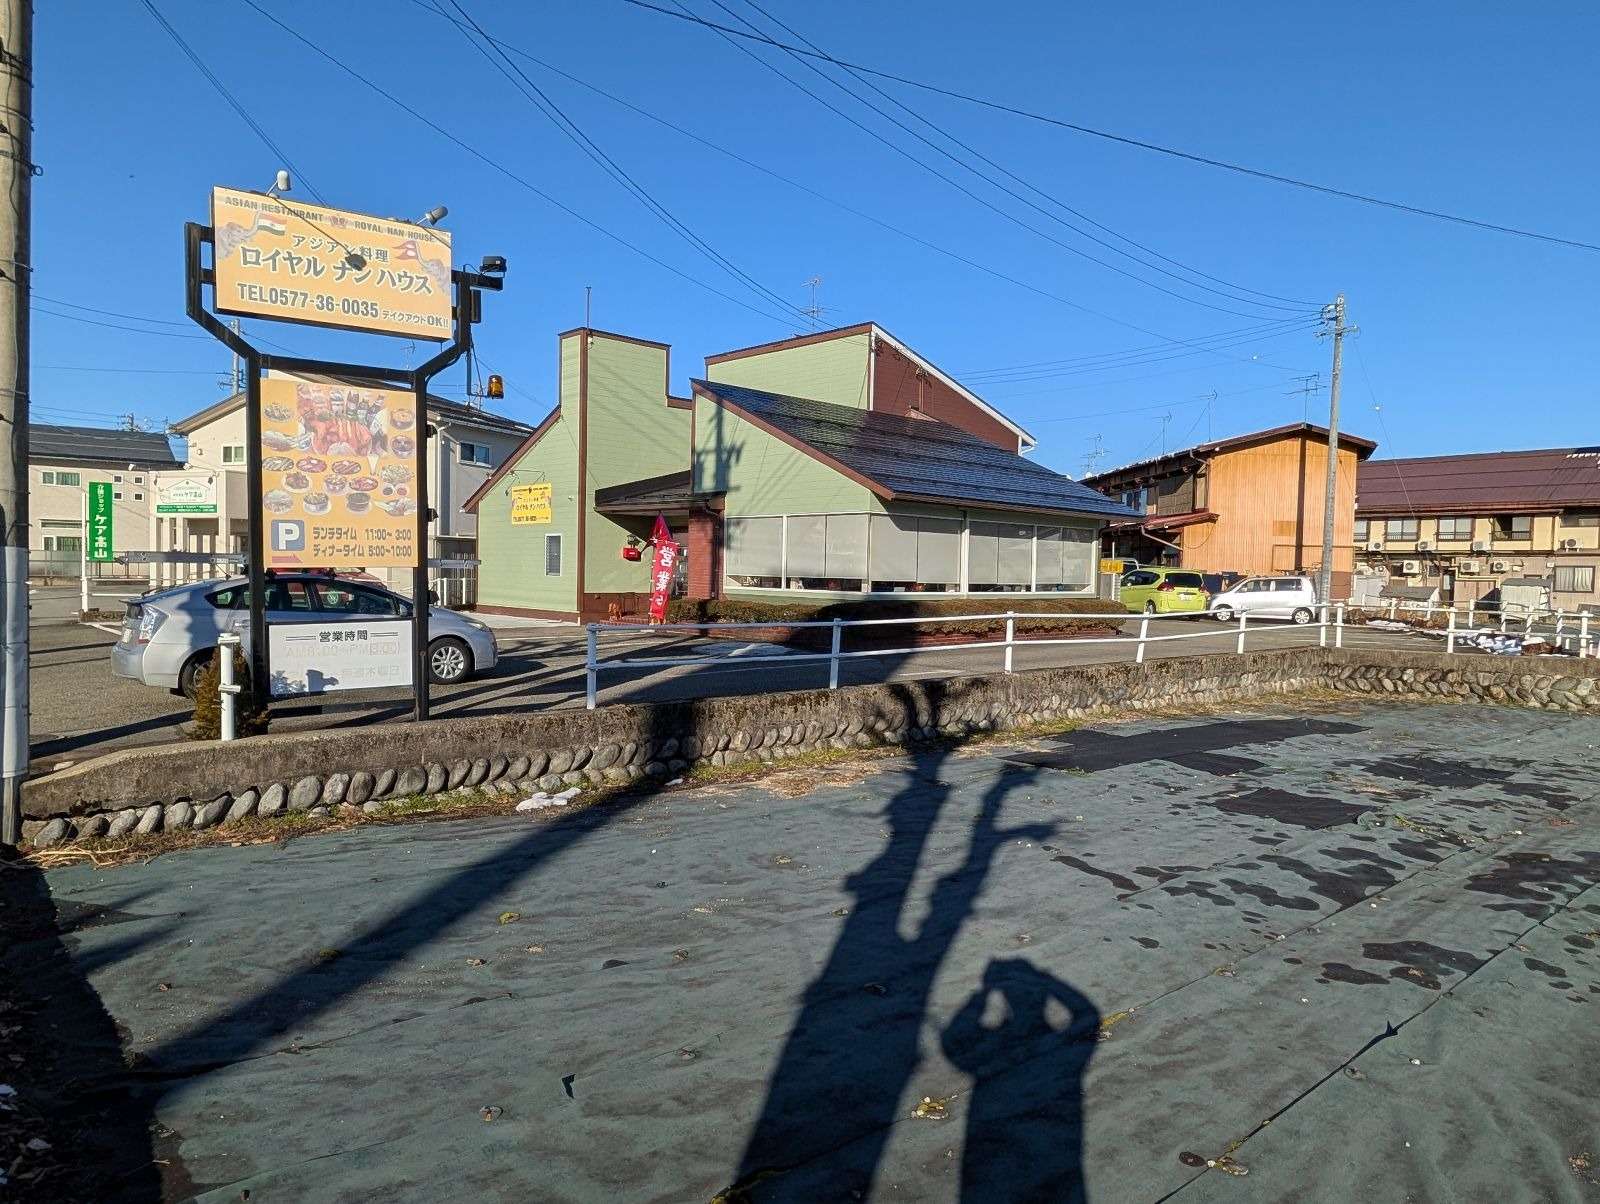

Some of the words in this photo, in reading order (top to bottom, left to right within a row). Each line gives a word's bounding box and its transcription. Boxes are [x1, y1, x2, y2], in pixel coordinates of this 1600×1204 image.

[225, 196, 258, 211] ASIAN
[261, 203, 324, 222] RESTAURANT
[354, 221, 383, 233] ROYAL
[407, 232, 435, 243] HOUSE
[240, 246, 326, 278] ロイヤル
[376, 270, 433, 295] ハウス
[237, 282, 380, 318] TEL0577-36-0035
[94, 514, 108, 558] ケア高山
[278, 522, 300, 550] P
[312, 526, 357, 540] ランチタイム
[313, 543, 365, 558] ディナータイム
[318, 629, 368, 643] 営業時間
